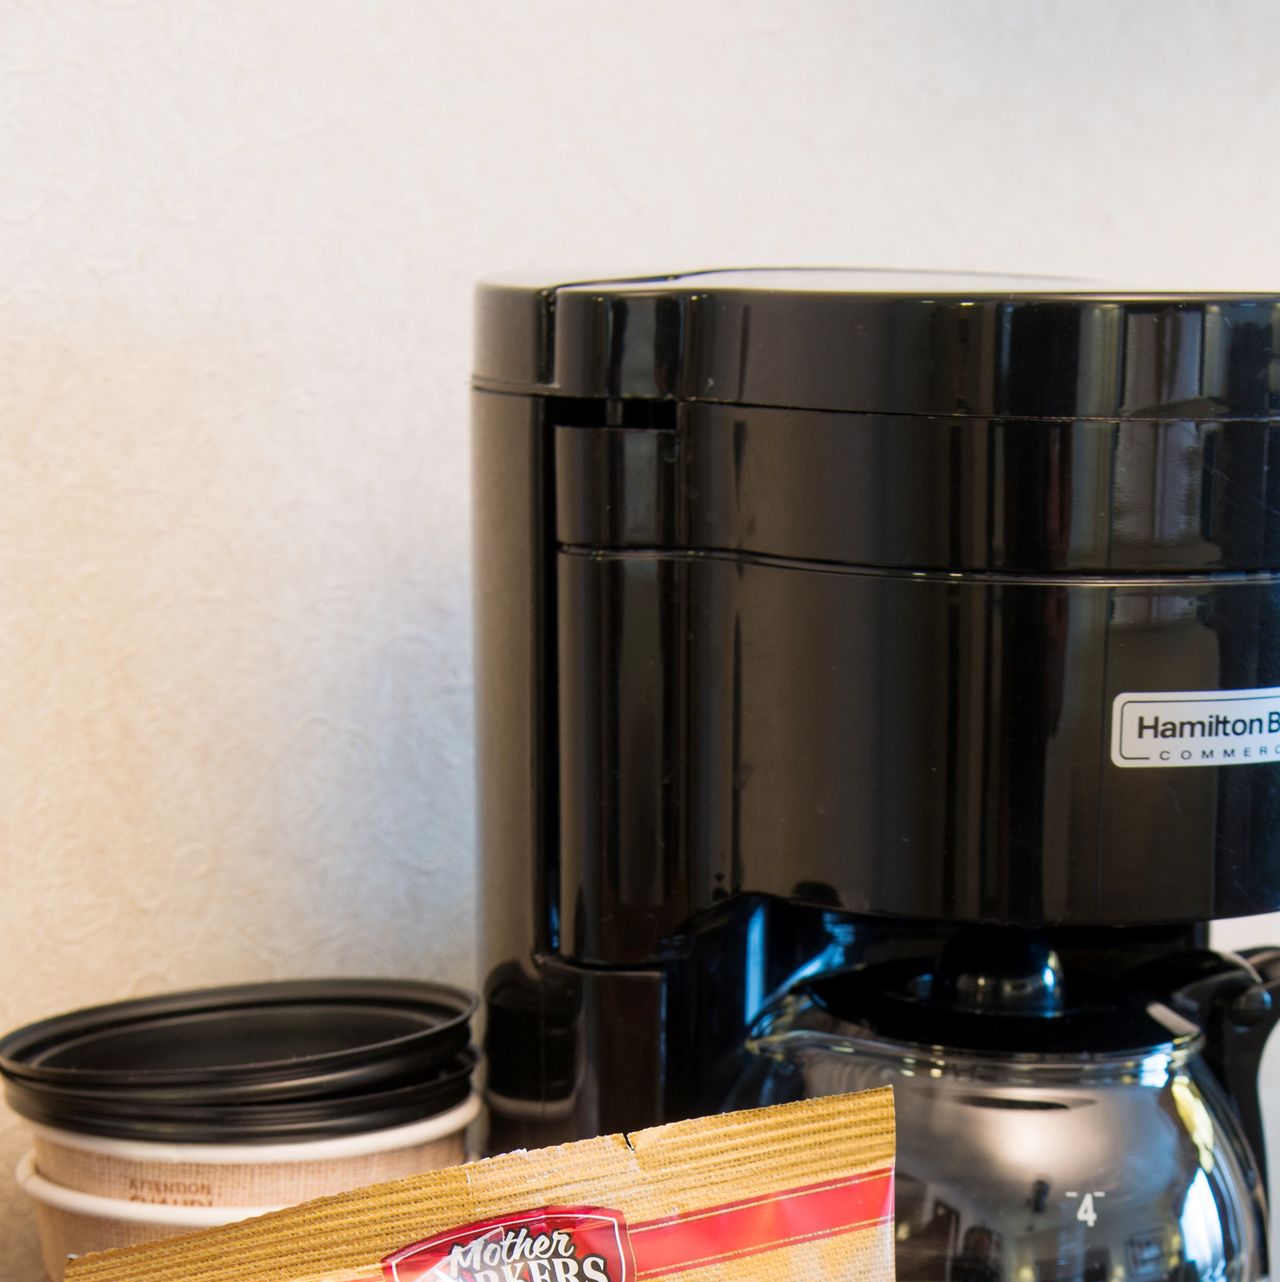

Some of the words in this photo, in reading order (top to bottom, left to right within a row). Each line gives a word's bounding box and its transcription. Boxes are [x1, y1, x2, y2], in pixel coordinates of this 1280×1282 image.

[1136, 712, 1264, 740] Hamilton
[1076, 1193, 1098, 1227] 4
[448, 1228, 575, 1278] Mother
